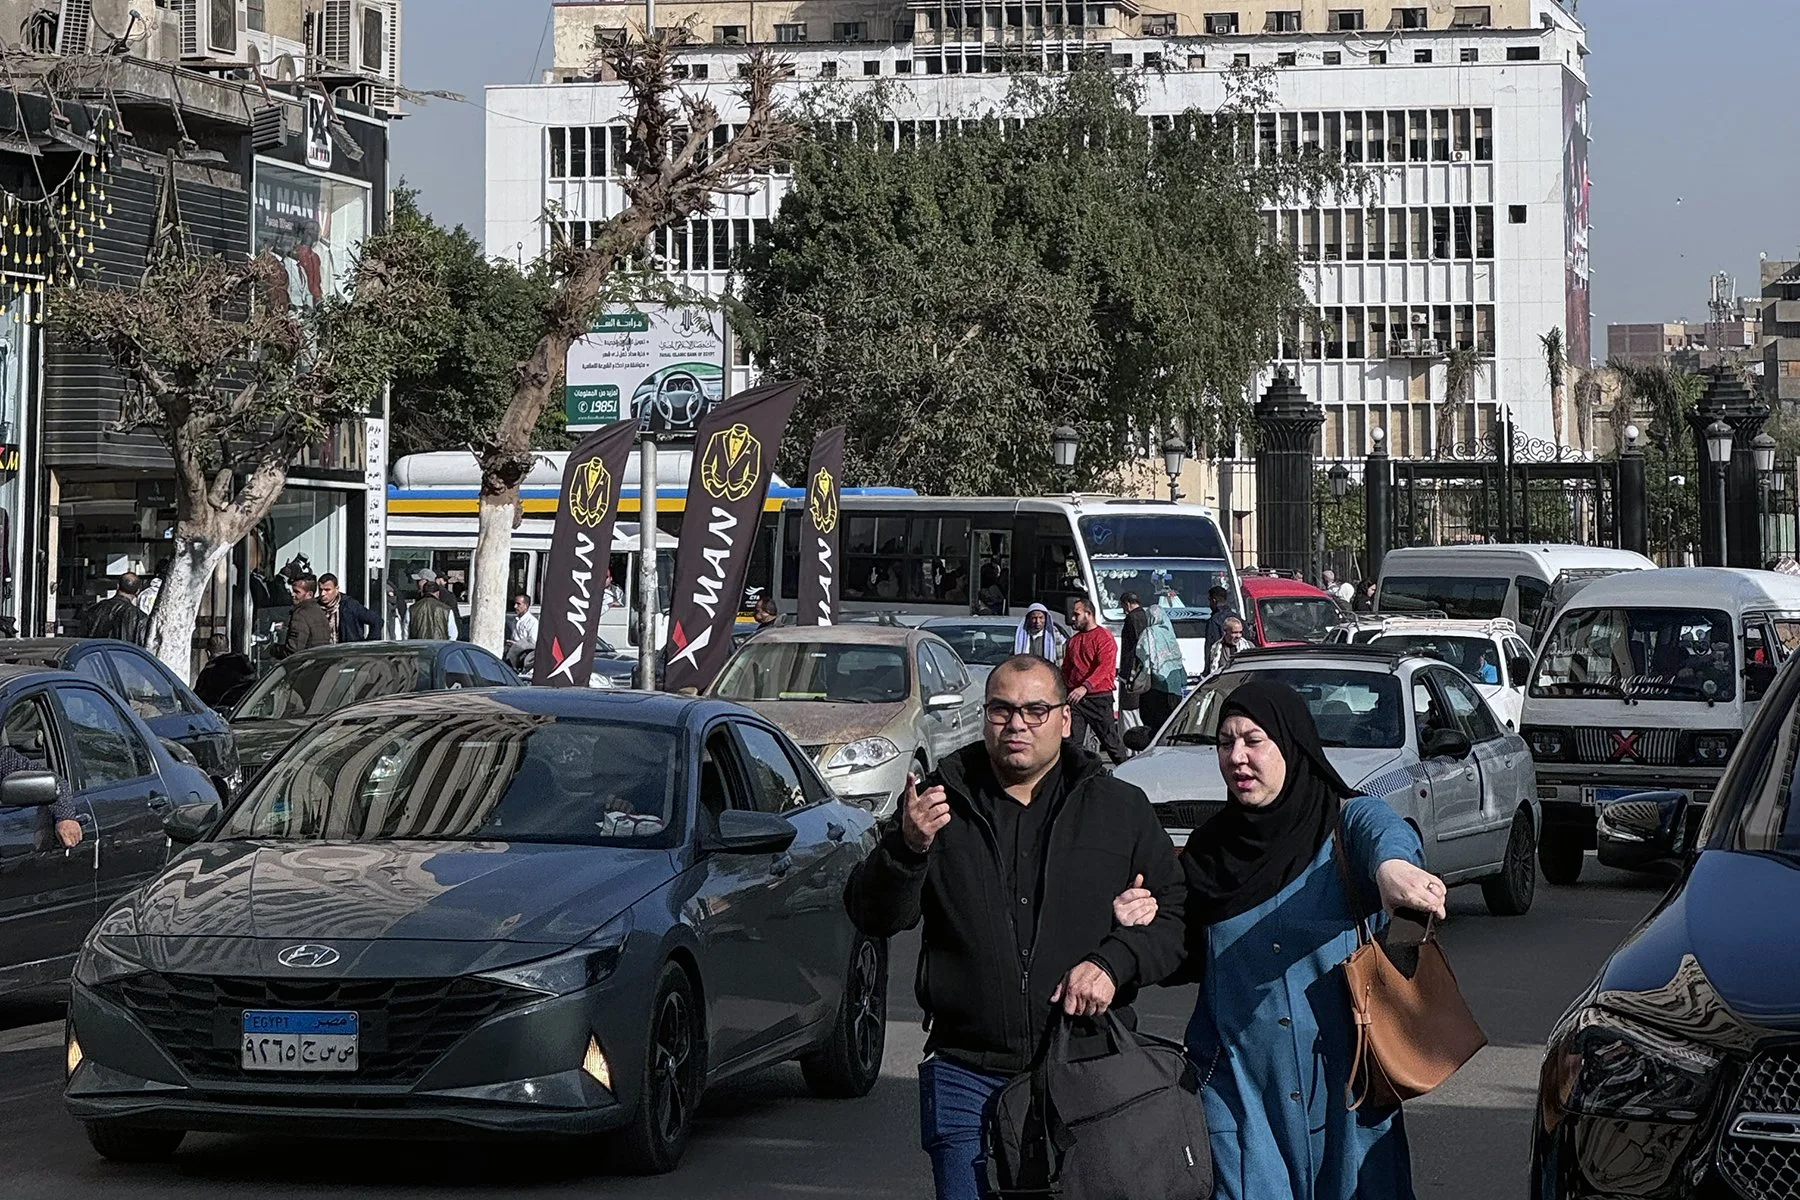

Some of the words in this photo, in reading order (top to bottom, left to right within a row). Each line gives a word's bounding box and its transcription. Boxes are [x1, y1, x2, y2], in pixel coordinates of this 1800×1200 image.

[276, 186, 314, 219] MAN
[573, 389, 598, 399] المعلومات
[598, 389, 606, 398] من
[589, 400, 618, 413] 19851
[693, 506, 738, 619] MAN
[567, 531, 595, 636] MAN
[253, 1016, 290, 1029] EGYPT
[313, 1016, 347, 1029] مصر
